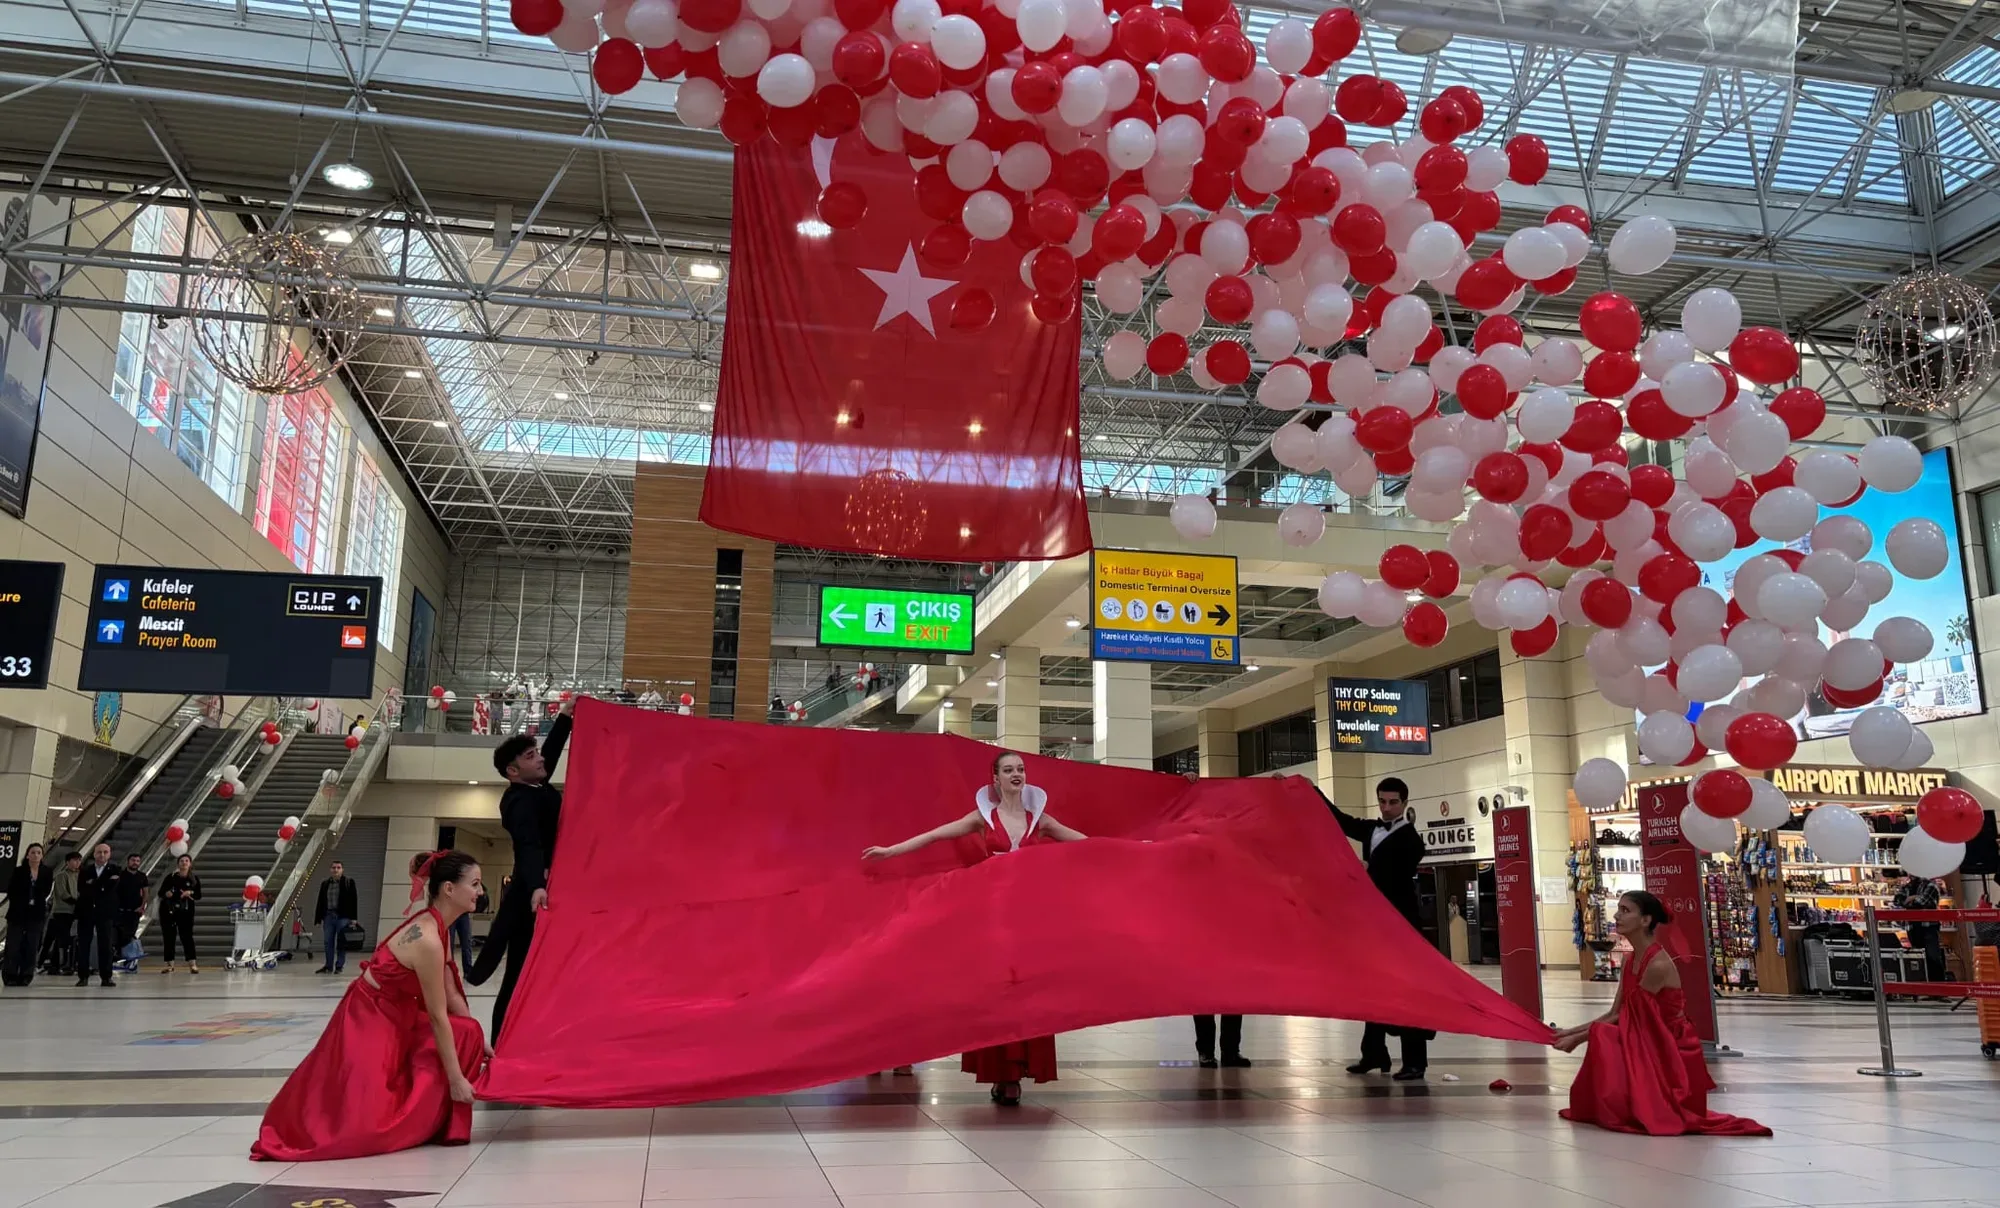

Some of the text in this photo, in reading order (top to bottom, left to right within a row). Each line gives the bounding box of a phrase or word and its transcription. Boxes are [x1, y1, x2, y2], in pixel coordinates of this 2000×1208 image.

[1111, 565, 1140, 576] Hatlar
[1143, 567, 1174, 579] Büyük
[1176, 569, 1204, 582] Bagaj
[143, 578, 194, 594] Kafeler
[1100, 580, 1232, 596] Domestic Terminal Oversize
[142, 595, 196, 611] Cafeteria
[295, 591, 336, 604] CIP
[294, 604, 335, 612] LOUNGE
[906, 600, 961, 622] ÇIKIŞ
[139, 616, 184, 631] Mescit
[139, 631, 217, 650] Prayer Room
[905, 624, 951, 641] EXIT
[1101, 632, 1128, 641] Hareket
[1185, 637, 1205, 645] Yolcu
[1335, 687, 1401, 700] THY CIP Salonu
[1336, 700, 1398, 716] THY CIP Lounge
[1337, 732, 1362, 744] Toilets
[1773, 768, 1947, 796] AIRPORT MARKET
[1646, 816, 1677, 828] TURKISH
[1648, 826, 1679, 838] AIRLINES
